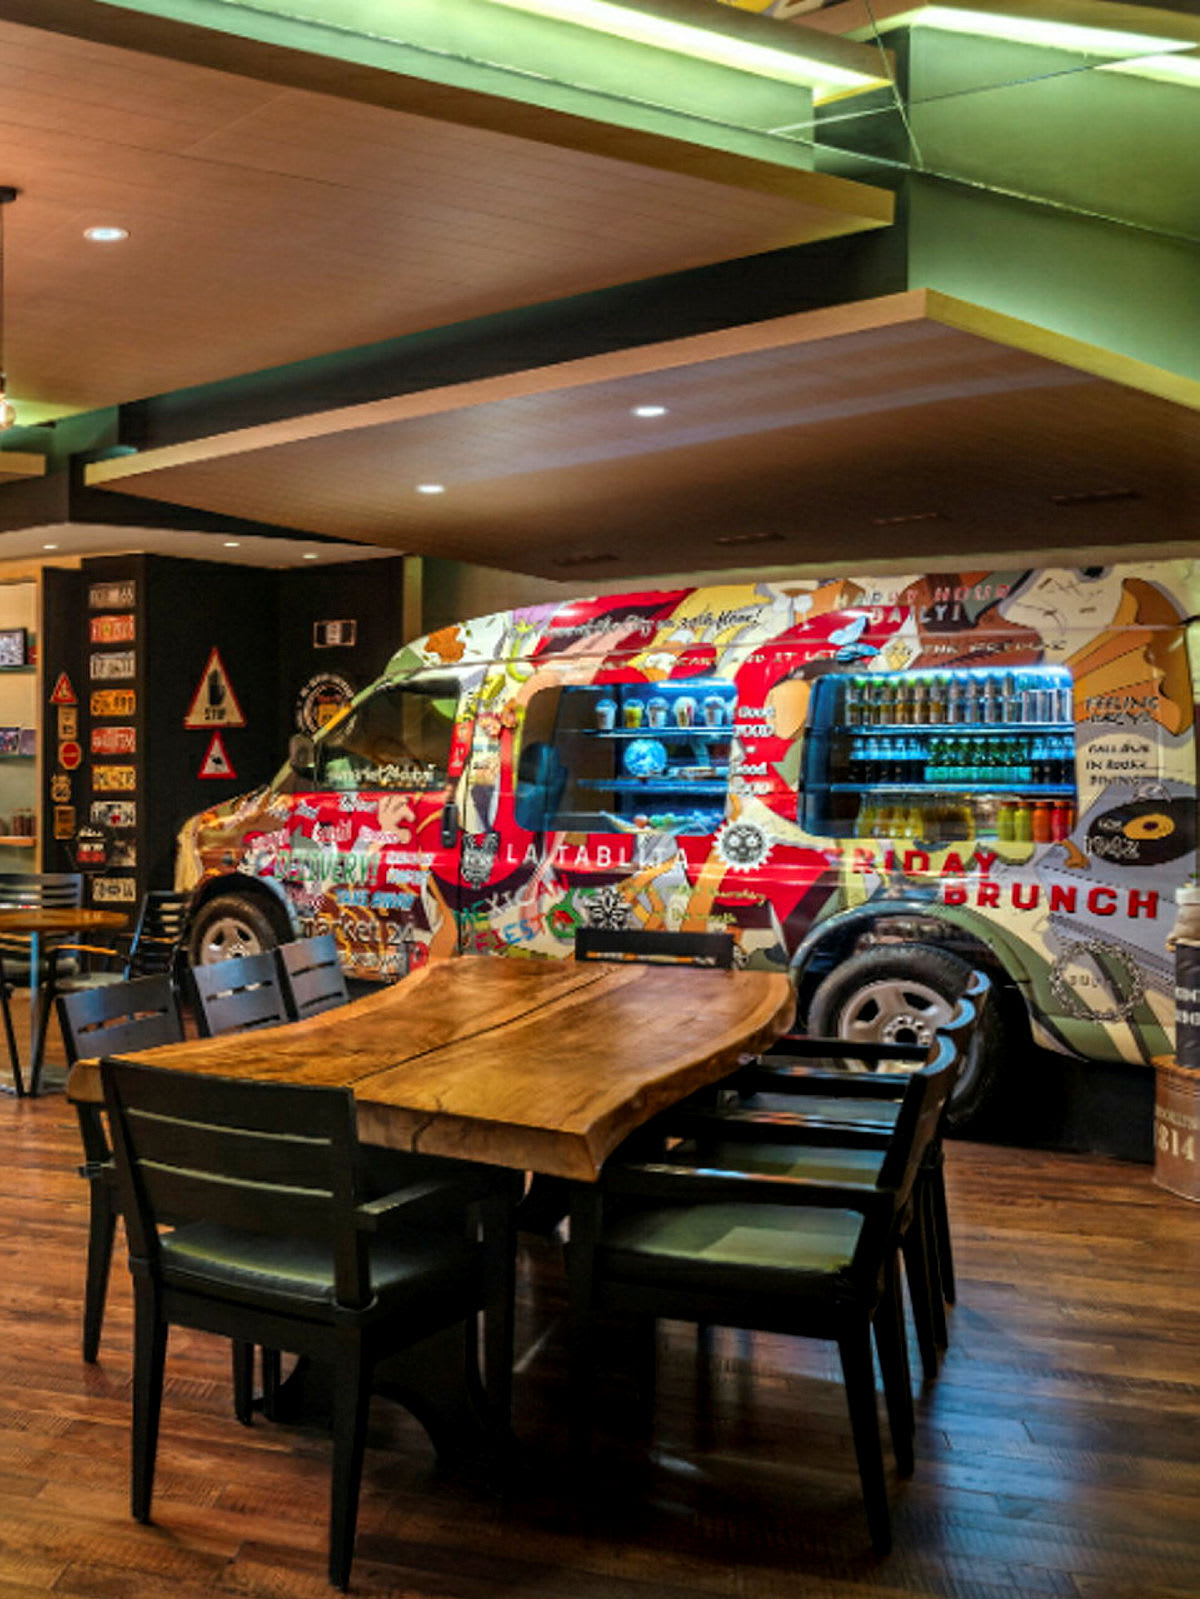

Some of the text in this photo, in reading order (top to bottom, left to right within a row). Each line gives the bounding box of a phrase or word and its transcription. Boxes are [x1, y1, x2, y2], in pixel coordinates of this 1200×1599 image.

[1085, 697, 1159, 711] FEELING
[506, 844, 690, 871] LA TABLITA
[822, 847, 997, 879] FRIDAY
[942, 883, 1159, 920] BRUNCH
